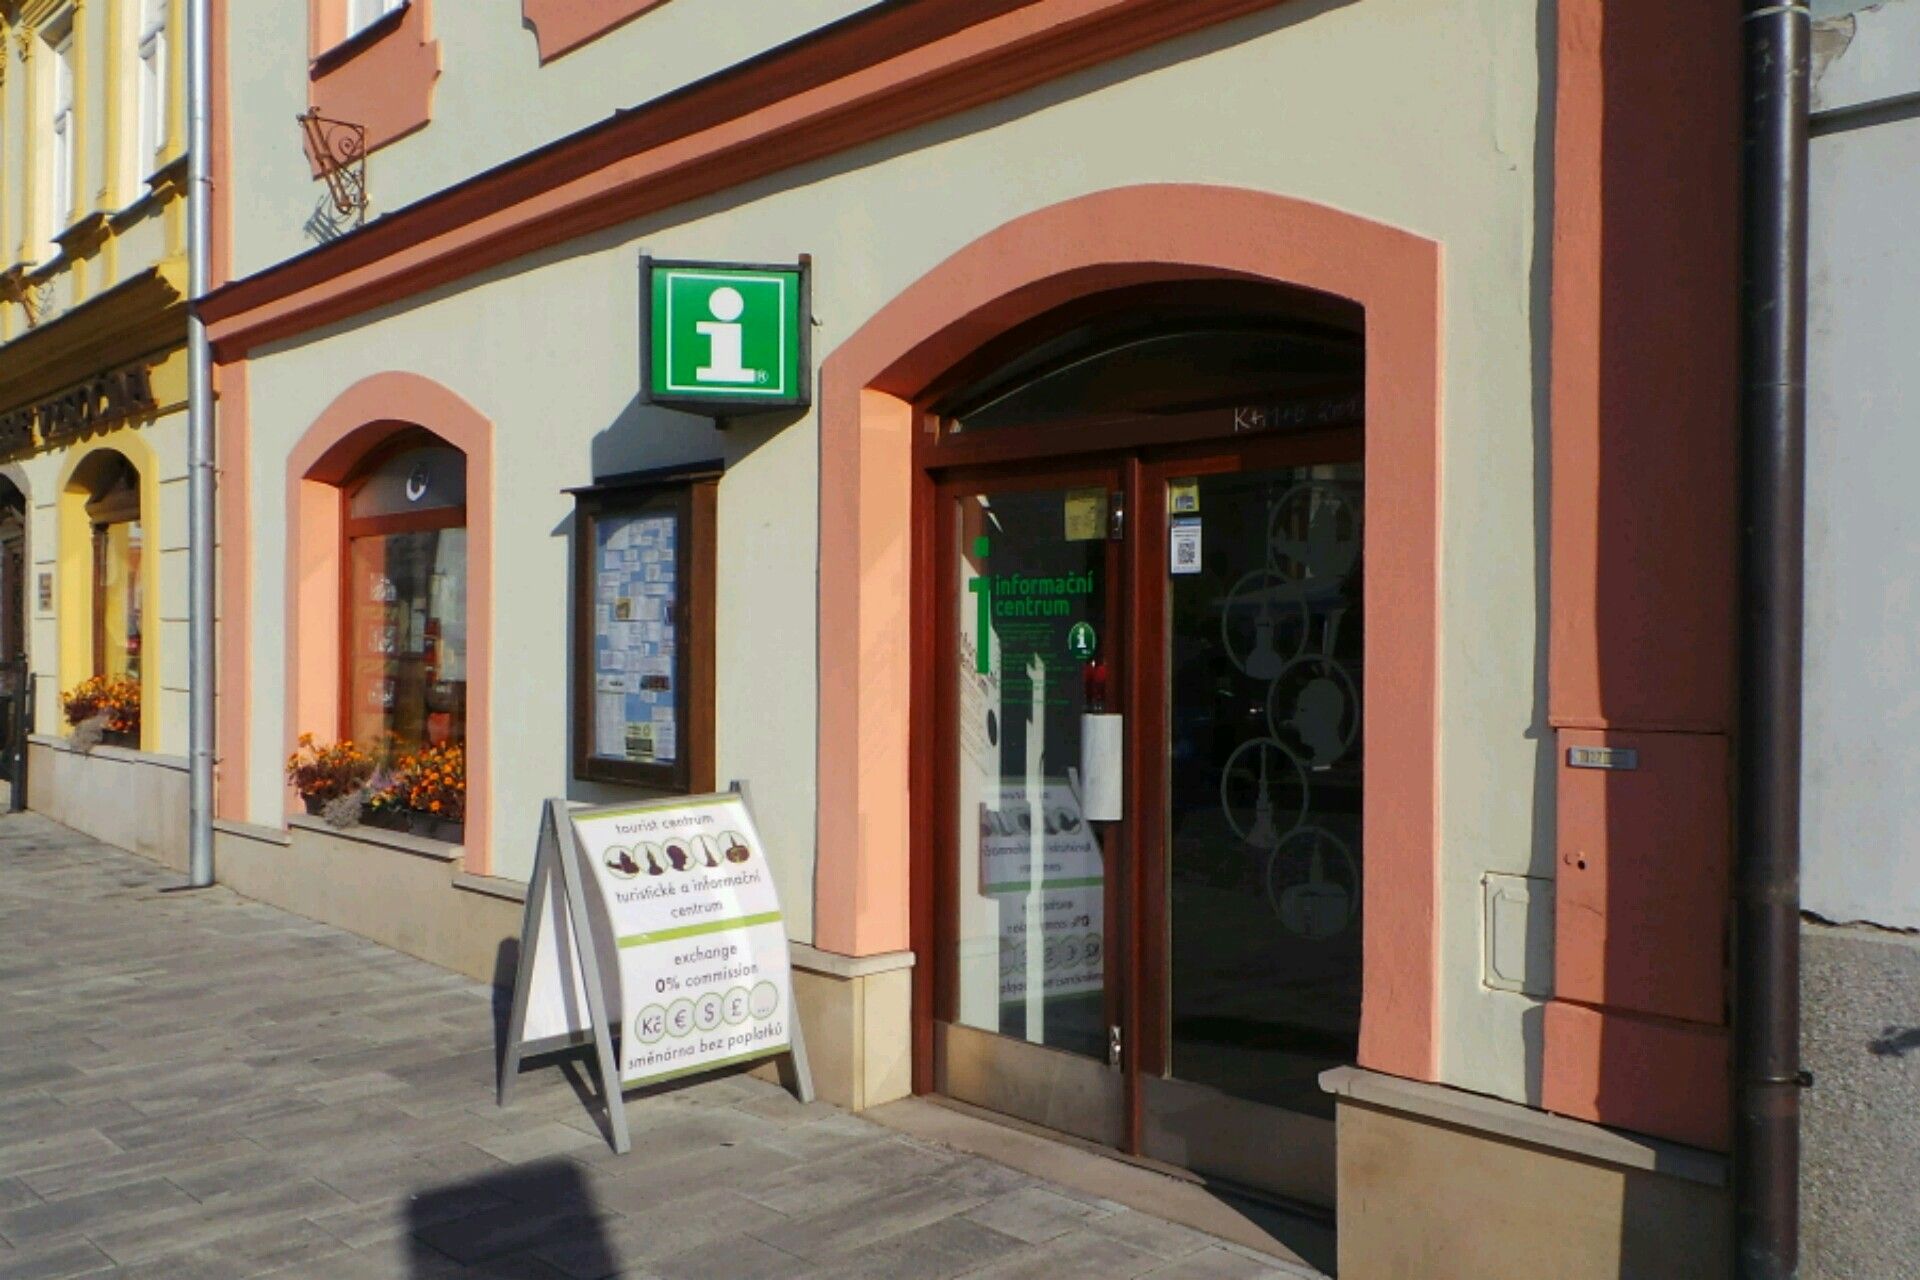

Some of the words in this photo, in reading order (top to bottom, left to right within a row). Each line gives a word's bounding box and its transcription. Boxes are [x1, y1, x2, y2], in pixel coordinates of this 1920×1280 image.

[995, 570, 1094, 595] informační
[995, 597, 1071, 617] centrum
[615, 819, 658, 835] tourist
[662, 814, 715, 830] centrum
[615, 882, 676, 903] turistické
[681, 884, 690, 894] a
[693, 870, 762, 891] informační
[670, 901, 723, 918] centrum
[674, 945, 738, 966] exchange
[655, 976, 680, 993] 0%
[685, 963, 759, 987] commission
[642, 1015, 661, 1036] Kč
[628, 1044, 695, 1070] směnárna
[700, 1037, 723, 1053] bez
[727, 1022, 783, 1050] poplatků
